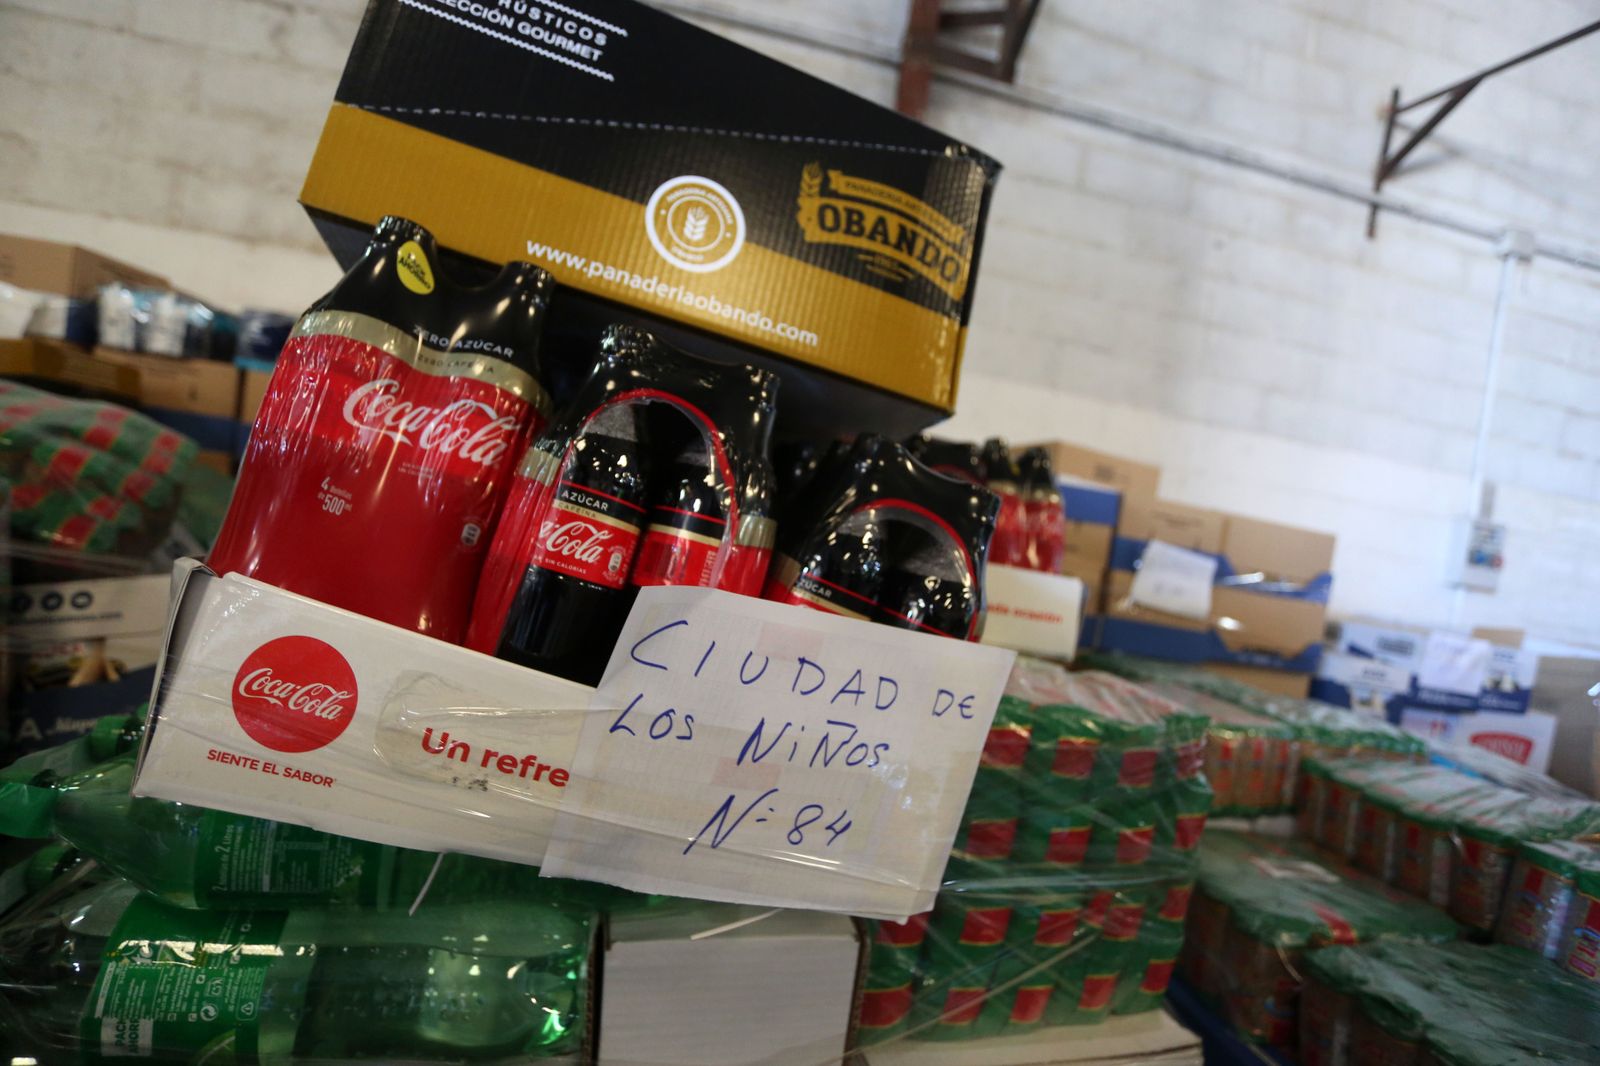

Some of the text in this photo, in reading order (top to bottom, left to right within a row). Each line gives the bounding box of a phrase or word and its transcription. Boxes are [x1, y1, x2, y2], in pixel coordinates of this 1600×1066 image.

[517, 21, 603, 62] GOURMET
[818, 203, 961, 284] OBANDO
[446, 357, 495, 374] CAFEA
[454, 339, 515, 359] AZÚCAR
[343, 377, 522, 467] Coca-Cola
[322, 493, 345, 516] 500
[560, 489, 609, 512] AZÚCAR
[630, 618, 977, 721] CIUDAD DE
[238, 667, 354, 721] Coca-Cola
[207, 748, 335, 789] SIENTE EL SABOR
[421, 727, 571, 789] Un refre
[786, 803, 854, 847] 84
